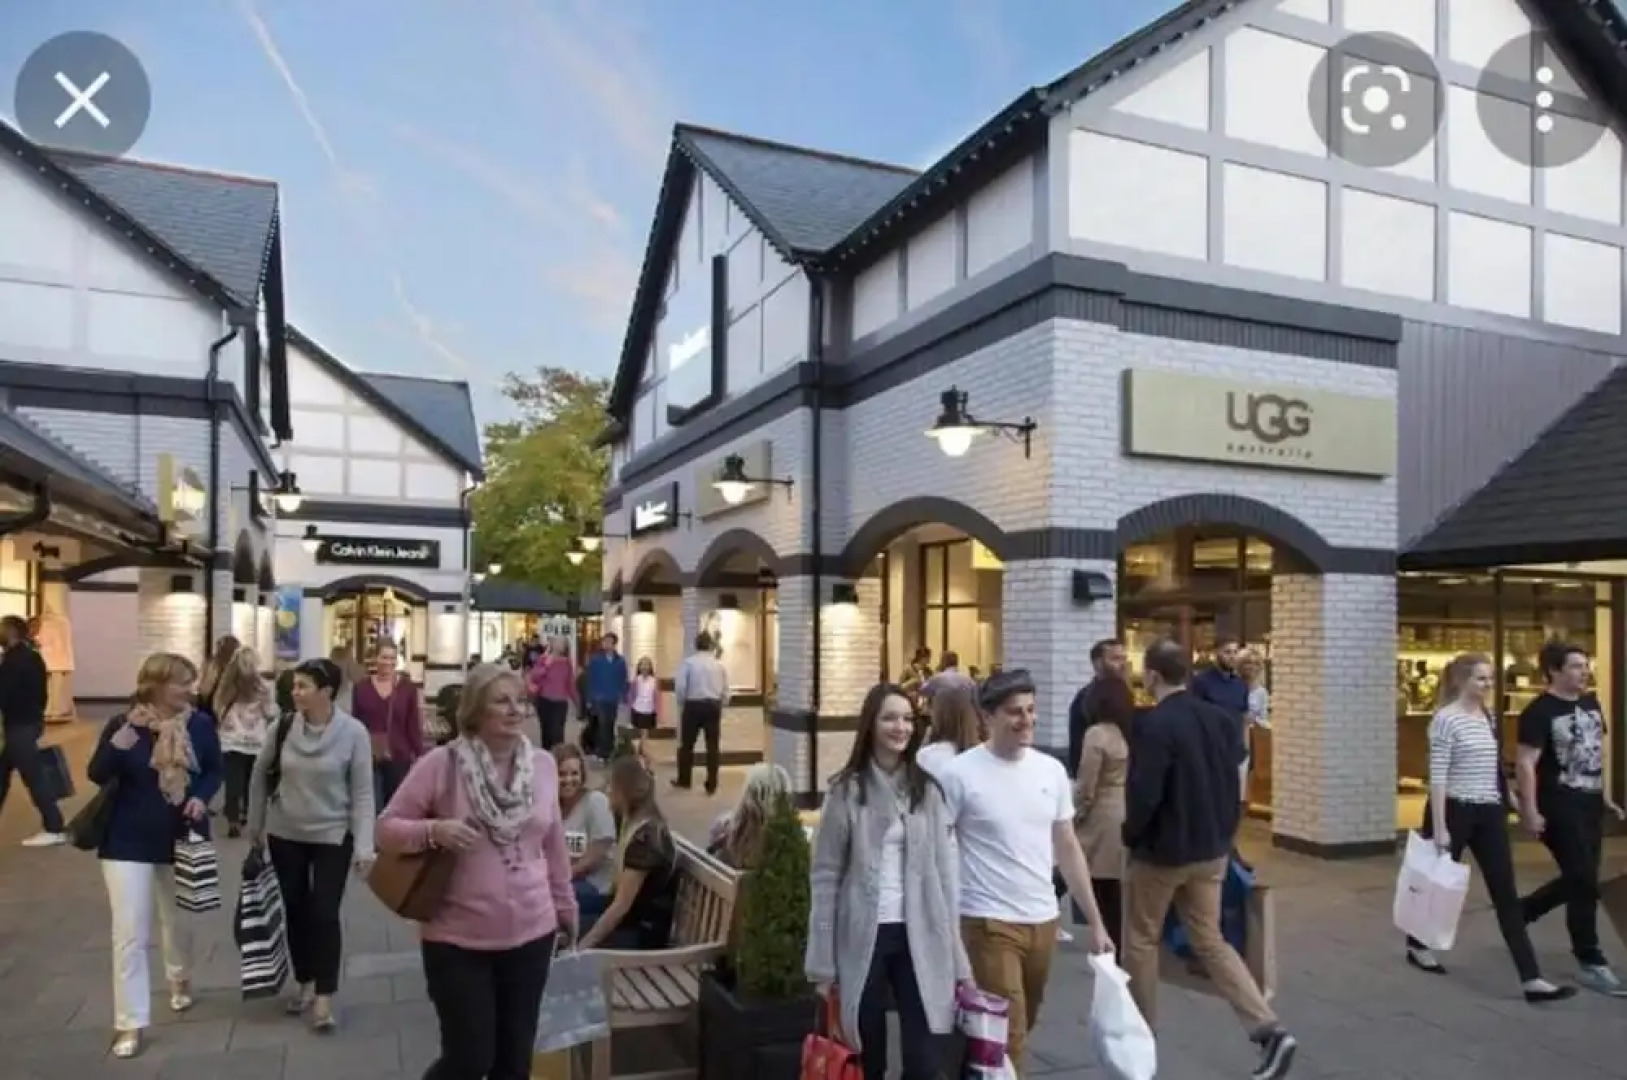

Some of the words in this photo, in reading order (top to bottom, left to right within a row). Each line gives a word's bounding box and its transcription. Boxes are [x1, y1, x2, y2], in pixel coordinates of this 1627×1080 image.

[1226, 391, 1310, 443] UGG
[331, 542, 367, 558] Calvin
[367, 544, 395, 559] Klein
